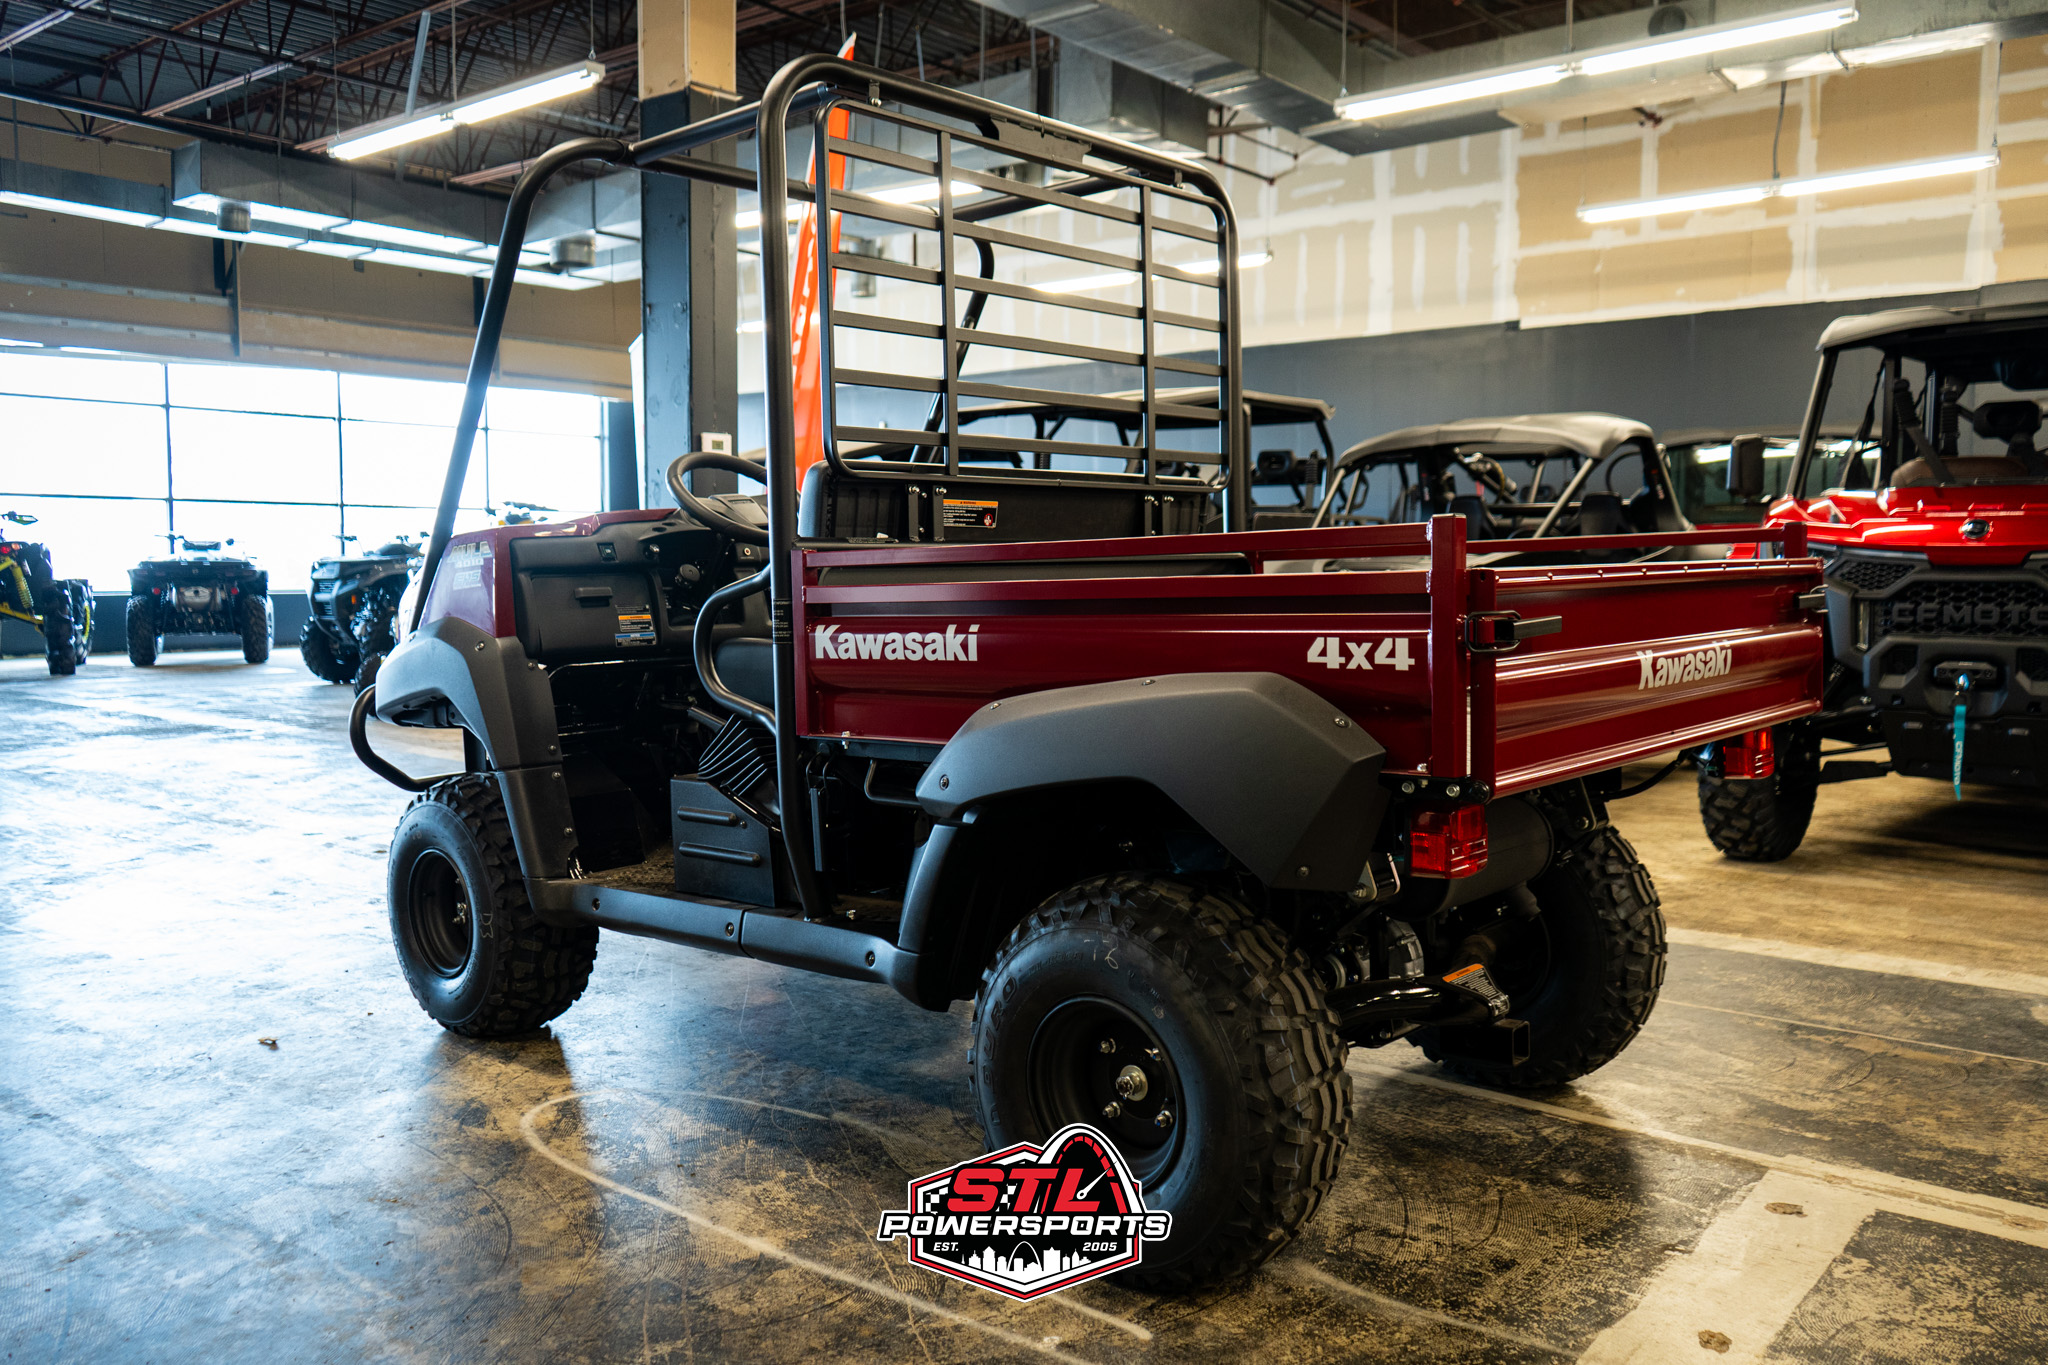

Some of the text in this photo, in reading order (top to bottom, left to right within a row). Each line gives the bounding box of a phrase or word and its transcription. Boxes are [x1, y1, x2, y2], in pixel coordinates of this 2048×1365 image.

[814, 624, 979, 661] Kawasaki
[1307, 636, 1415, 671] 4x4
[1636, 639, 1732, 690] Kawasaki
[982, 976, 1017, 1096] DURO
